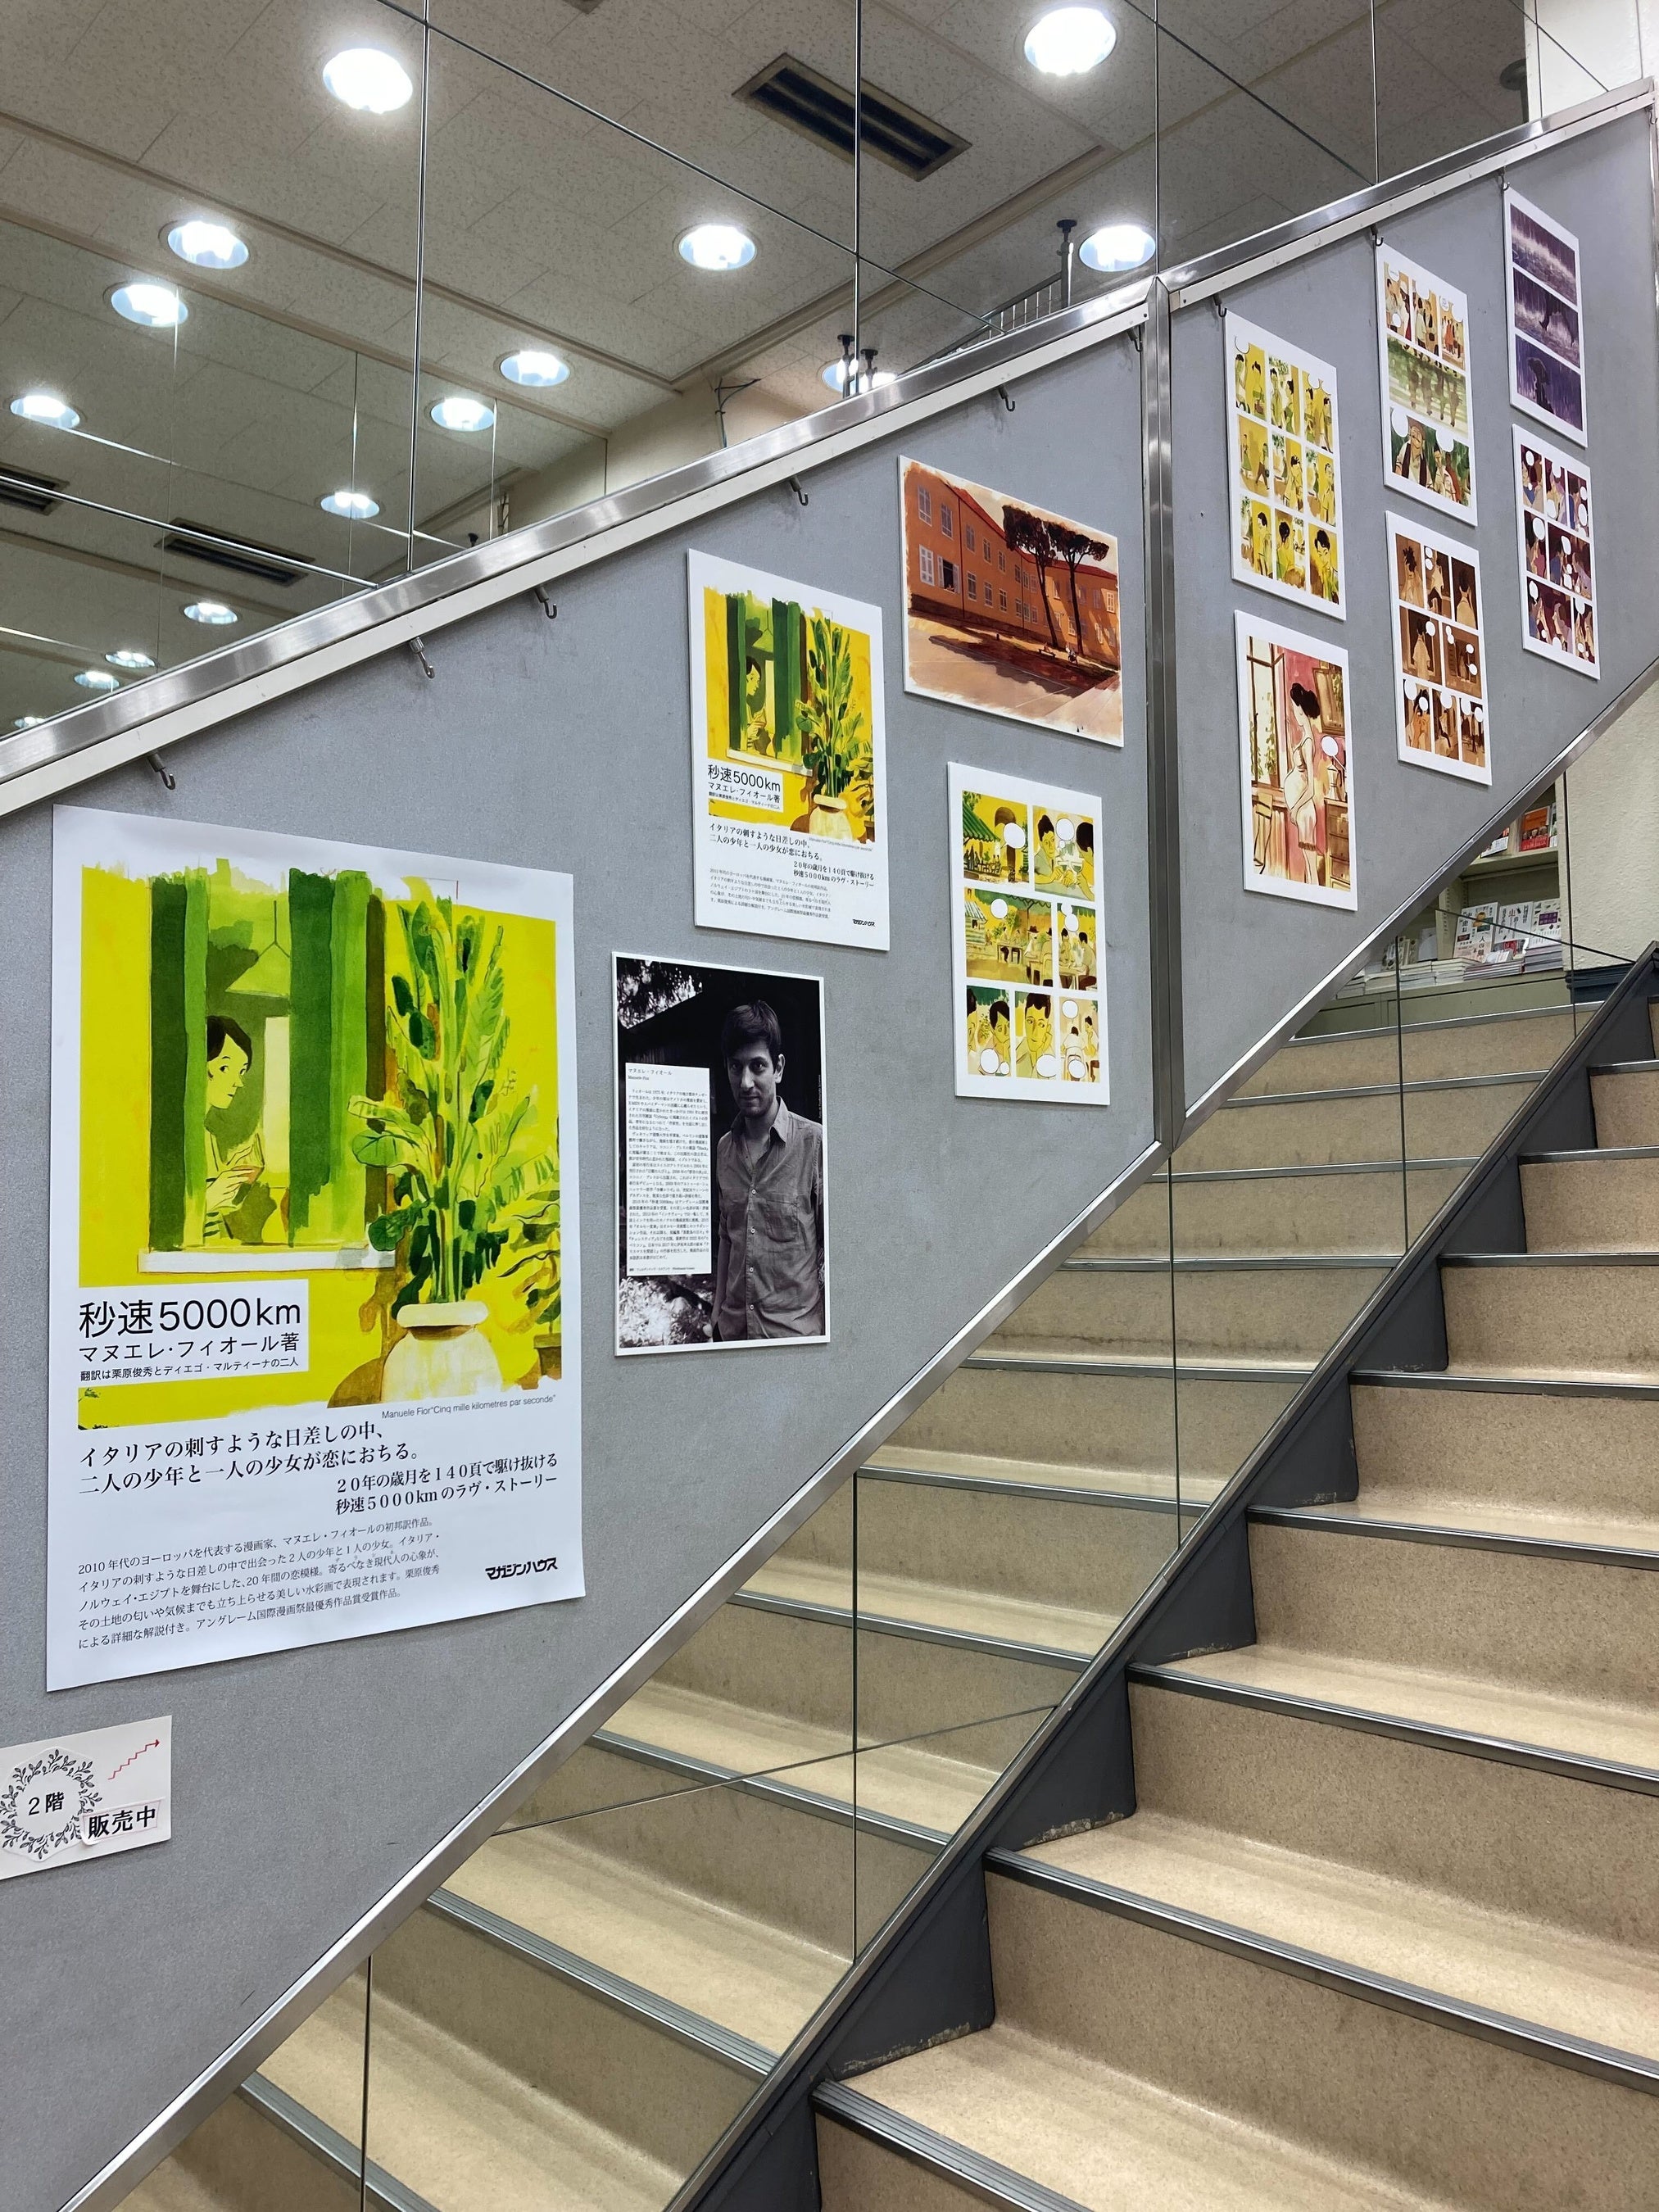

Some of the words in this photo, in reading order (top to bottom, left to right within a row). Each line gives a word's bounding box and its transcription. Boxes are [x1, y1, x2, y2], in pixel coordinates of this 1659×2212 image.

[708, 764, 781, 792] 秒速5000km
[79, 1298, 301, 1339] 秒速5000km
[79, 1332, 300, 1362] マヌエレ・フィオール著
[80, 1357, 299, 1381] 翻訳は栗原俊秀とディエゴ・マルティーナの二人
[382, 1407, 415, 1419] Manuele
[453, 1403, 470, 1412] mille
[471, 1400, 508, 1410] kilometres
[509, 1398, 522, 1408] par
[79, 1421, 383, 1467] イタリアの刺すような日差しの中、
[79, 1443, 417, 1494] 二人の少年と一人の少女が恋におちる。
[485, 1557, 558, 1580] マガジンハウス
[28, 1791, 65, 1815] 2階
[88, 1805, 156, 1839] 販売中
